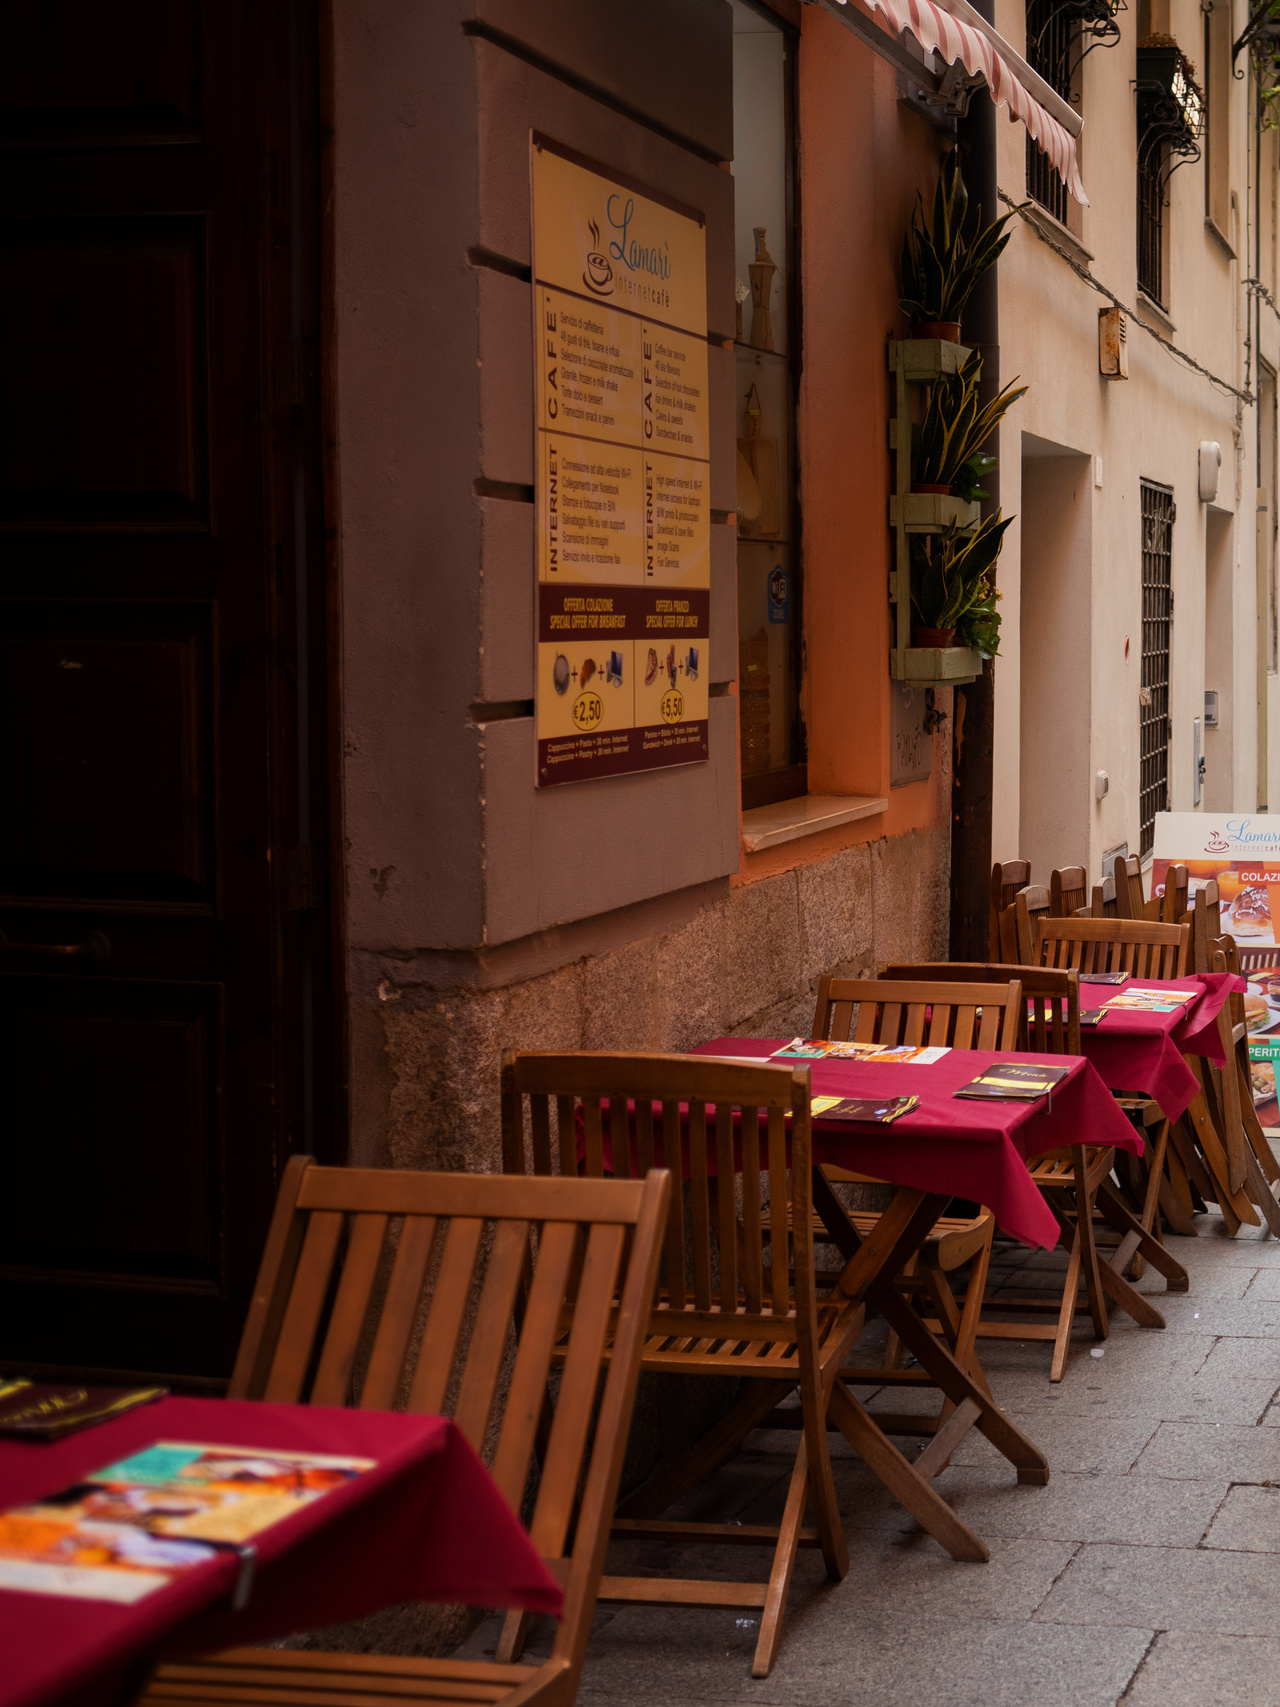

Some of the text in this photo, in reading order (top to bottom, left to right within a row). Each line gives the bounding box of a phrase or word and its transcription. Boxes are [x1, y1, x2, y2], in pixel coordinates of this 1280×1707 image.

[607, 194, 671, 280] Lamarì
[578, 335, 582, 347] di
[592, 339, 604, 353] tisane
[609, 344, 620, 358] infusi
[655, 342, 666, 356] Coffee
[674, 350, 685, 362] service
[561, 347, 581, 366] Selezione
[583, 354, 586, 366] di
[579, 371, 592, 386] frozen
[597, 375, 605, 389] milk
[606, 378, 618, 392] shake
[655, 375, 671, 390] Selection
[562, 384, 572, 399] Torte
[573, 388, 583, 402] dolci
[588, 392, 603, 407] dessert
[662, 394, 672, 407] drinks
[684, 401, 696, 413] shakes
[586, 410, 597, 424] snack
[602, 413, 614, 429] panini
[656, 409, 667, 422] Cakes
[671, 414, 683, 426] sweets
[656, 425, 676, 442] Sandwiches
[681, 431, 693, 444] snacks
[562, 457, 589, 473] Connessione
[590, 463, 595, 474] ad
[562, 476, 591, 494] Collegamento
[600, 482, 619, 495] Notebook
[665, 476, 675, 489] speed
[562, 494, 578, 510] Stampe
[583, 498, 602, 513] fotocopie
[671, 494, 682, 504] access
[562, 512, 586, 530] Salvataggio
[595, 519, 600, 528] su
[610, 518, 626, 533] supporti
[657, 523, 674, 536] Download
[562, 531, 609, 550] Scansione di immagini
[562, 549, 579, 563] Servizio
[581, 551, 590, 563] invio
[595, 552, 613, 565] ricezione
[665, 557, 679, 569] Services
[564, 598, 613, 612] OFFERTA COLAZIONE
[656, 600, 689, 613] OFFERTA PRANZO
[550, 615, 626, 629] SPECIAL OFFER FOR BREAKFAST
[646, 616, 698, 628] SPECIAL OFFER FOR LUNCH
[574, 700, 600, 724] €2,50
[662, 698, 682, 719] €5,50
[548, 742, 575, 753] Cappuccino
[580, 739, 592, 747] Pasta
[612, 735, 628, 743] Internet
[547, 752, 574, 764] Cappuccino
[579, 750, 593, 759] Pastry
[613, 745, 629, 753] Internet
